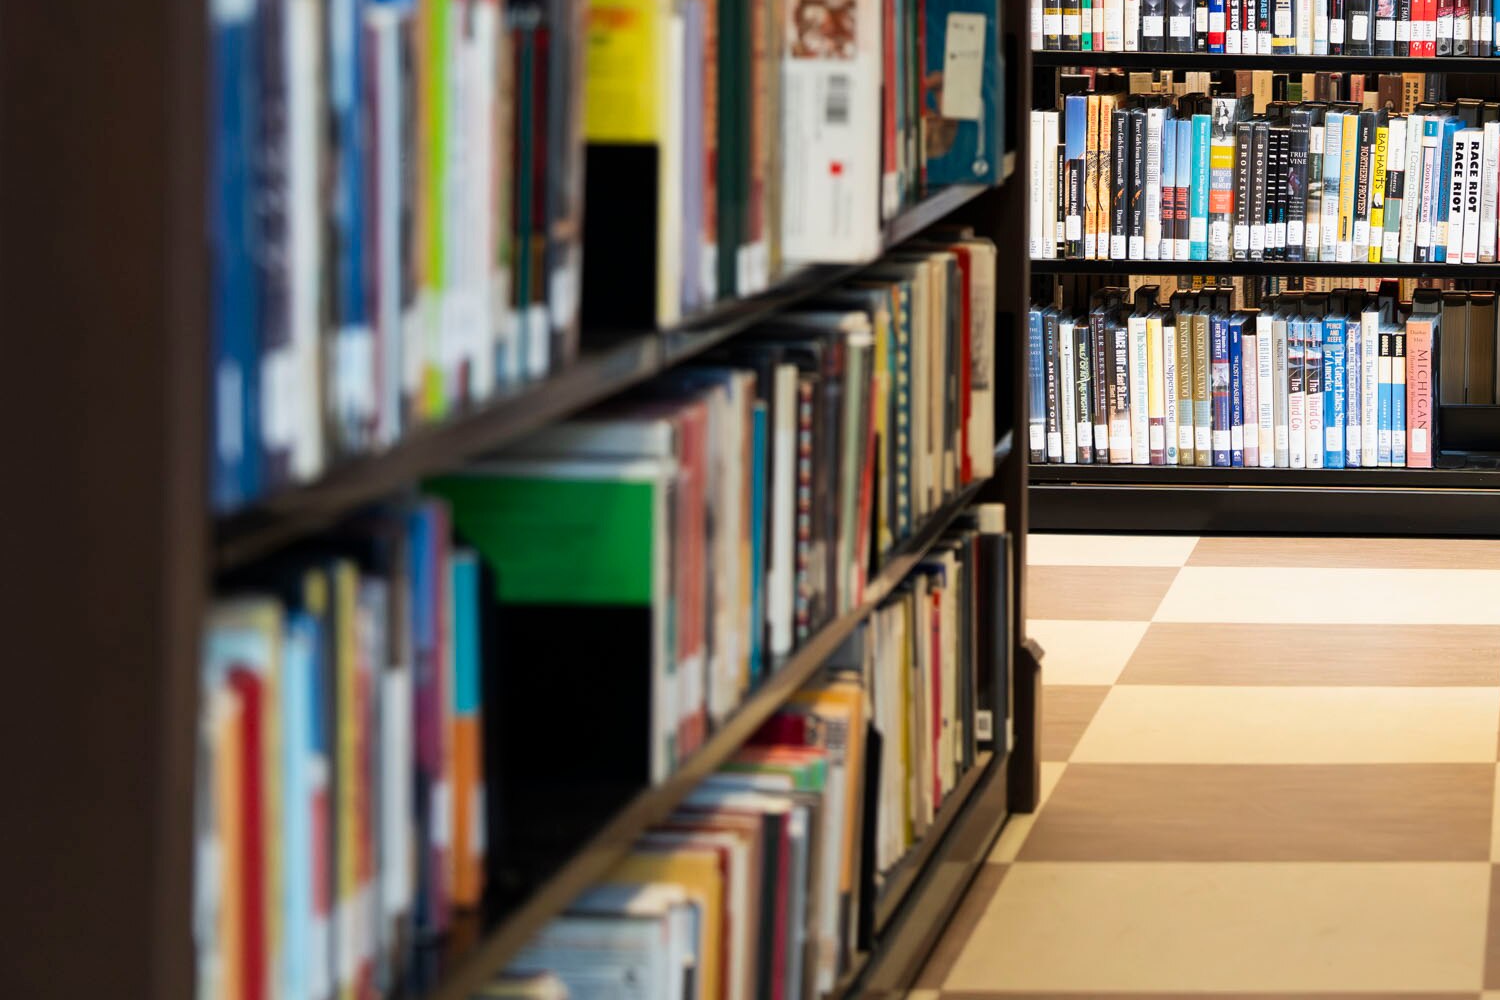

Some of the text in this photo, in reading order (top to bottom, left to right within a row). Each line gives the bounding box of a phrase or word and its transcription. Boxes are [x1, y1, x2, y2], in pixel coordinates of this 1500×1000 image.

[1376, 133, 1386, 152] BAD
[1357, 146, 1369, 215] NORTHERN PROTEST
[1452, 142, 1464, 213] RACE RIOT
[1468, 142, 1480, 212] RACE RIOT
[1097, 318, 1105, 346] NEVER
[1324, 360, 1334, 391] America
[1334, 352, 1344, 411] The Great Lakes
[1417, 350, 1428, 429] MICHIGAN
